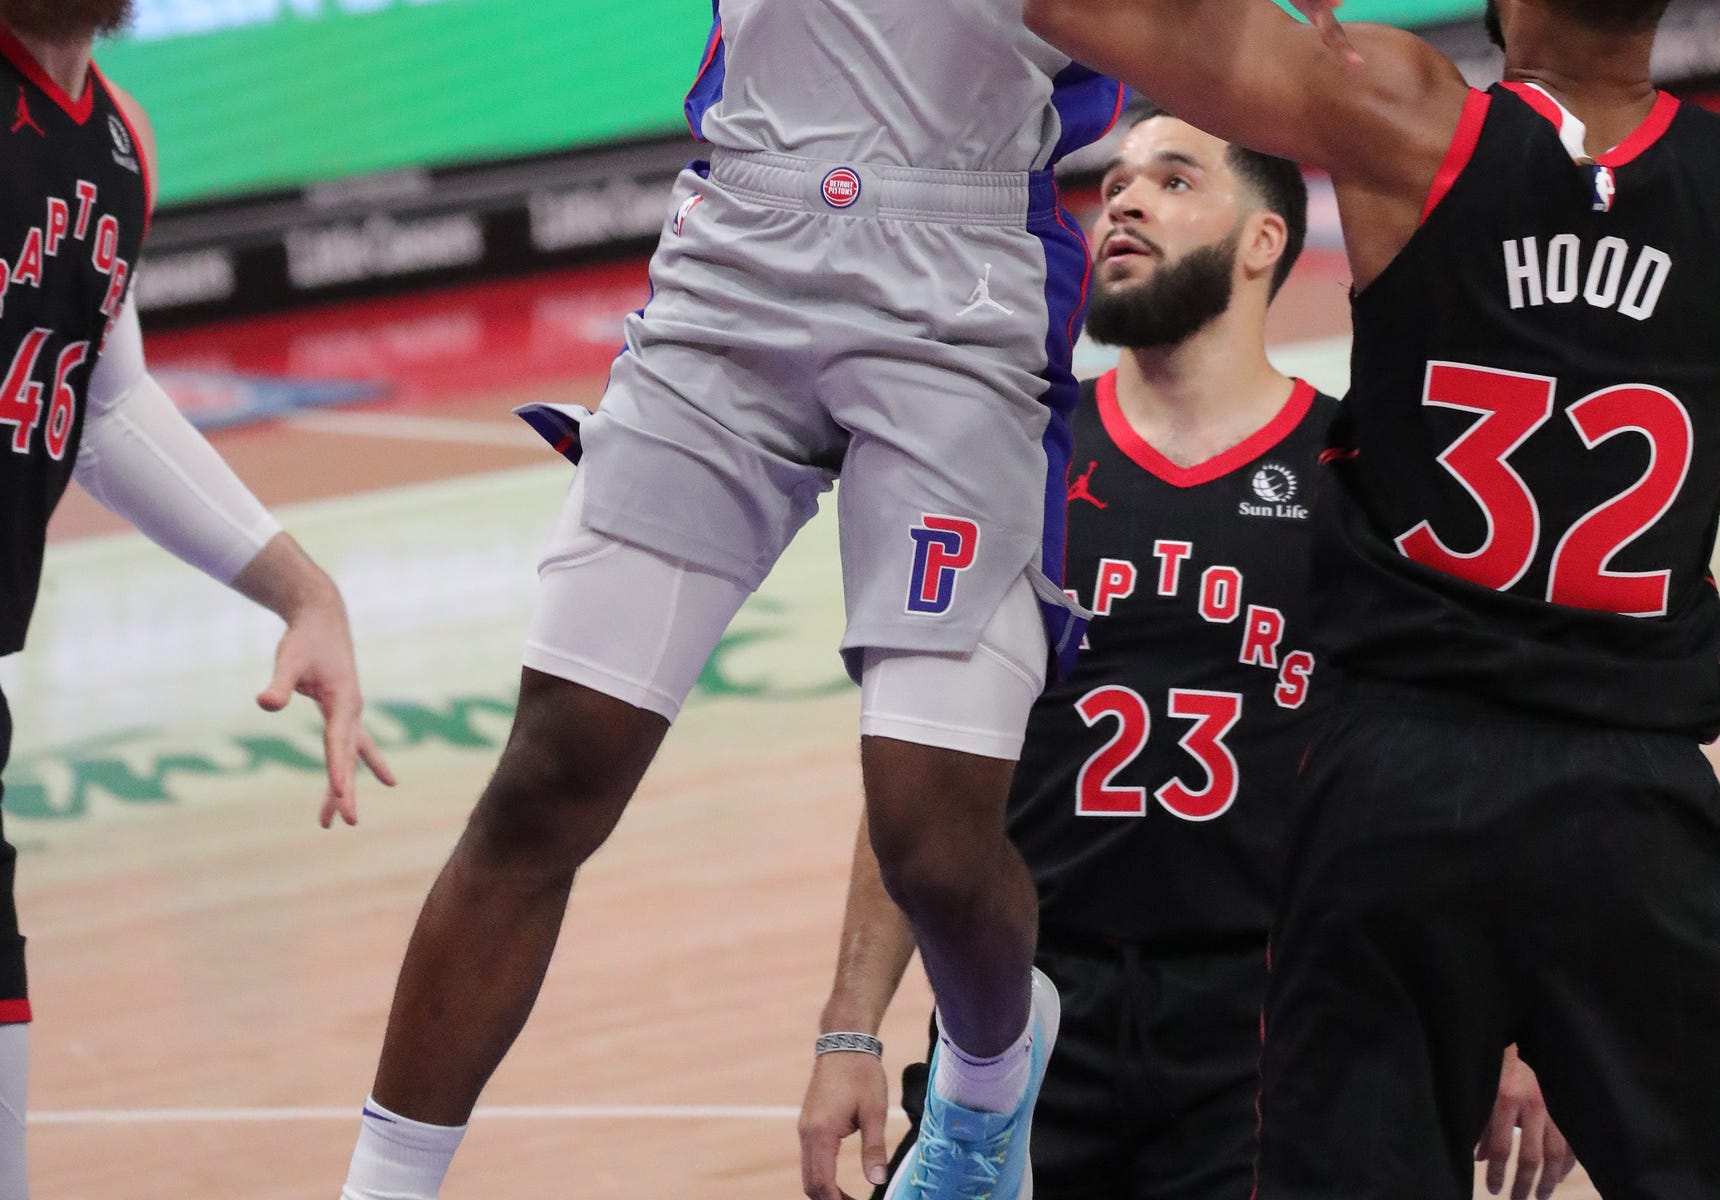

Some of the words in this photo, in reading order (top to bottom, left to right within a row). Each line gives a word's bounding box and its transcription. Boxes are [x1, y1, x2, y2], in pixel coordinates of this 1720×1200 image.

[828, 187, 853, 196] PISTONS
[829, 180, 853, 188] DETROIT
[1503, 234, 1672, 321] HOOD
[0, 328, 89, 461] 46
[1239, 502, 1273, 516] Sun
[1276, 504, 1309, 519] Life
[1395, 360, 1693, 618] 32
[1064, 539, 1316, 709] PTORS
[1074, 685, 1242, 821] 23
